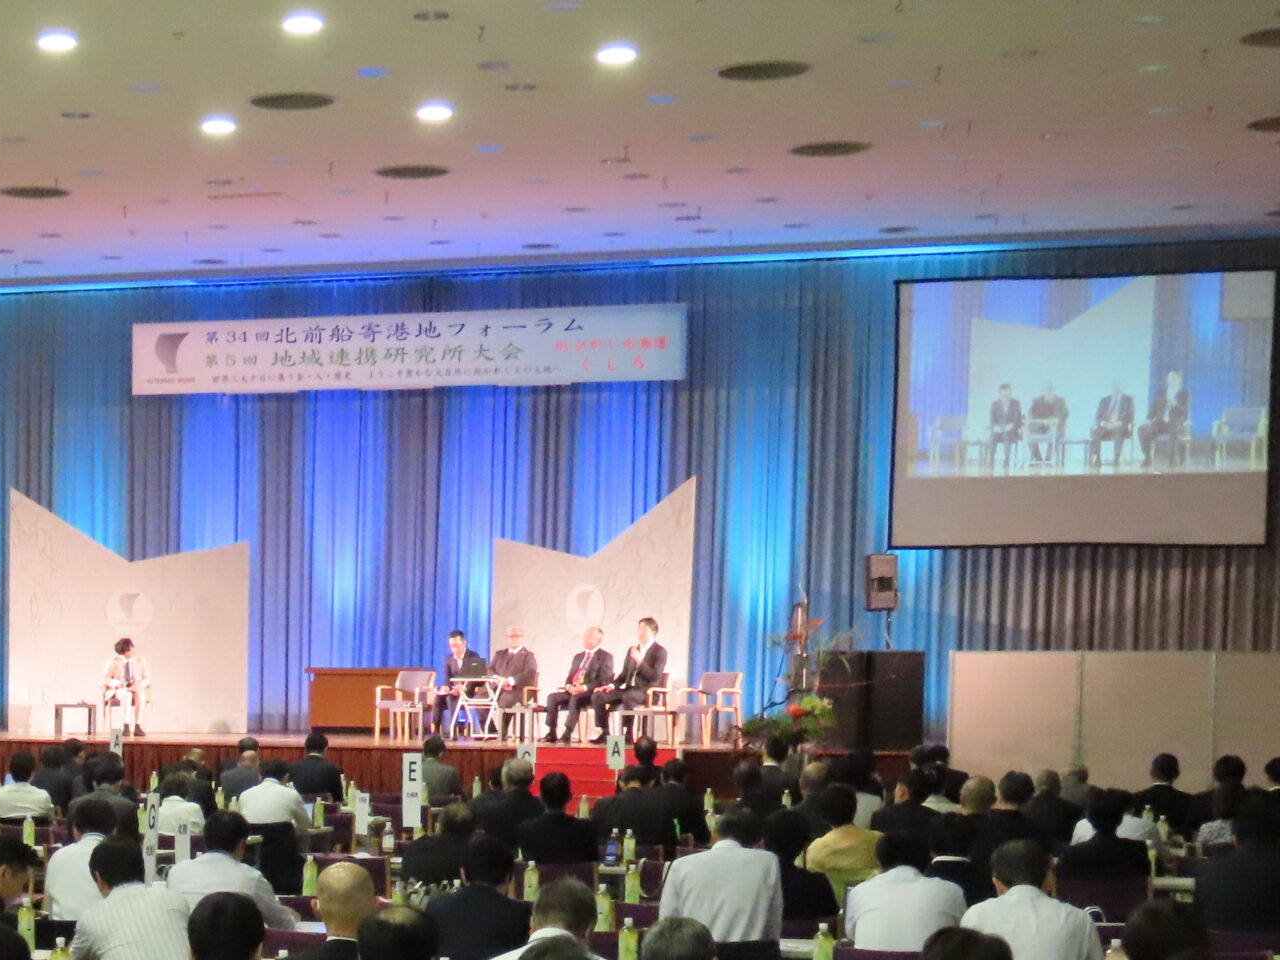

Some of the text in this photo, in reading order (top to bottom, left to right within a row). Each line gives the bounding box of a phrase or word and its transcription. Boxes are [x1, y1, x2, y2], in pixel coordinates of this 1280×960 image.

[611, 740, 621, 757] A
[408, 761, 418, 782] E
[148, 804, 156, 830] G
